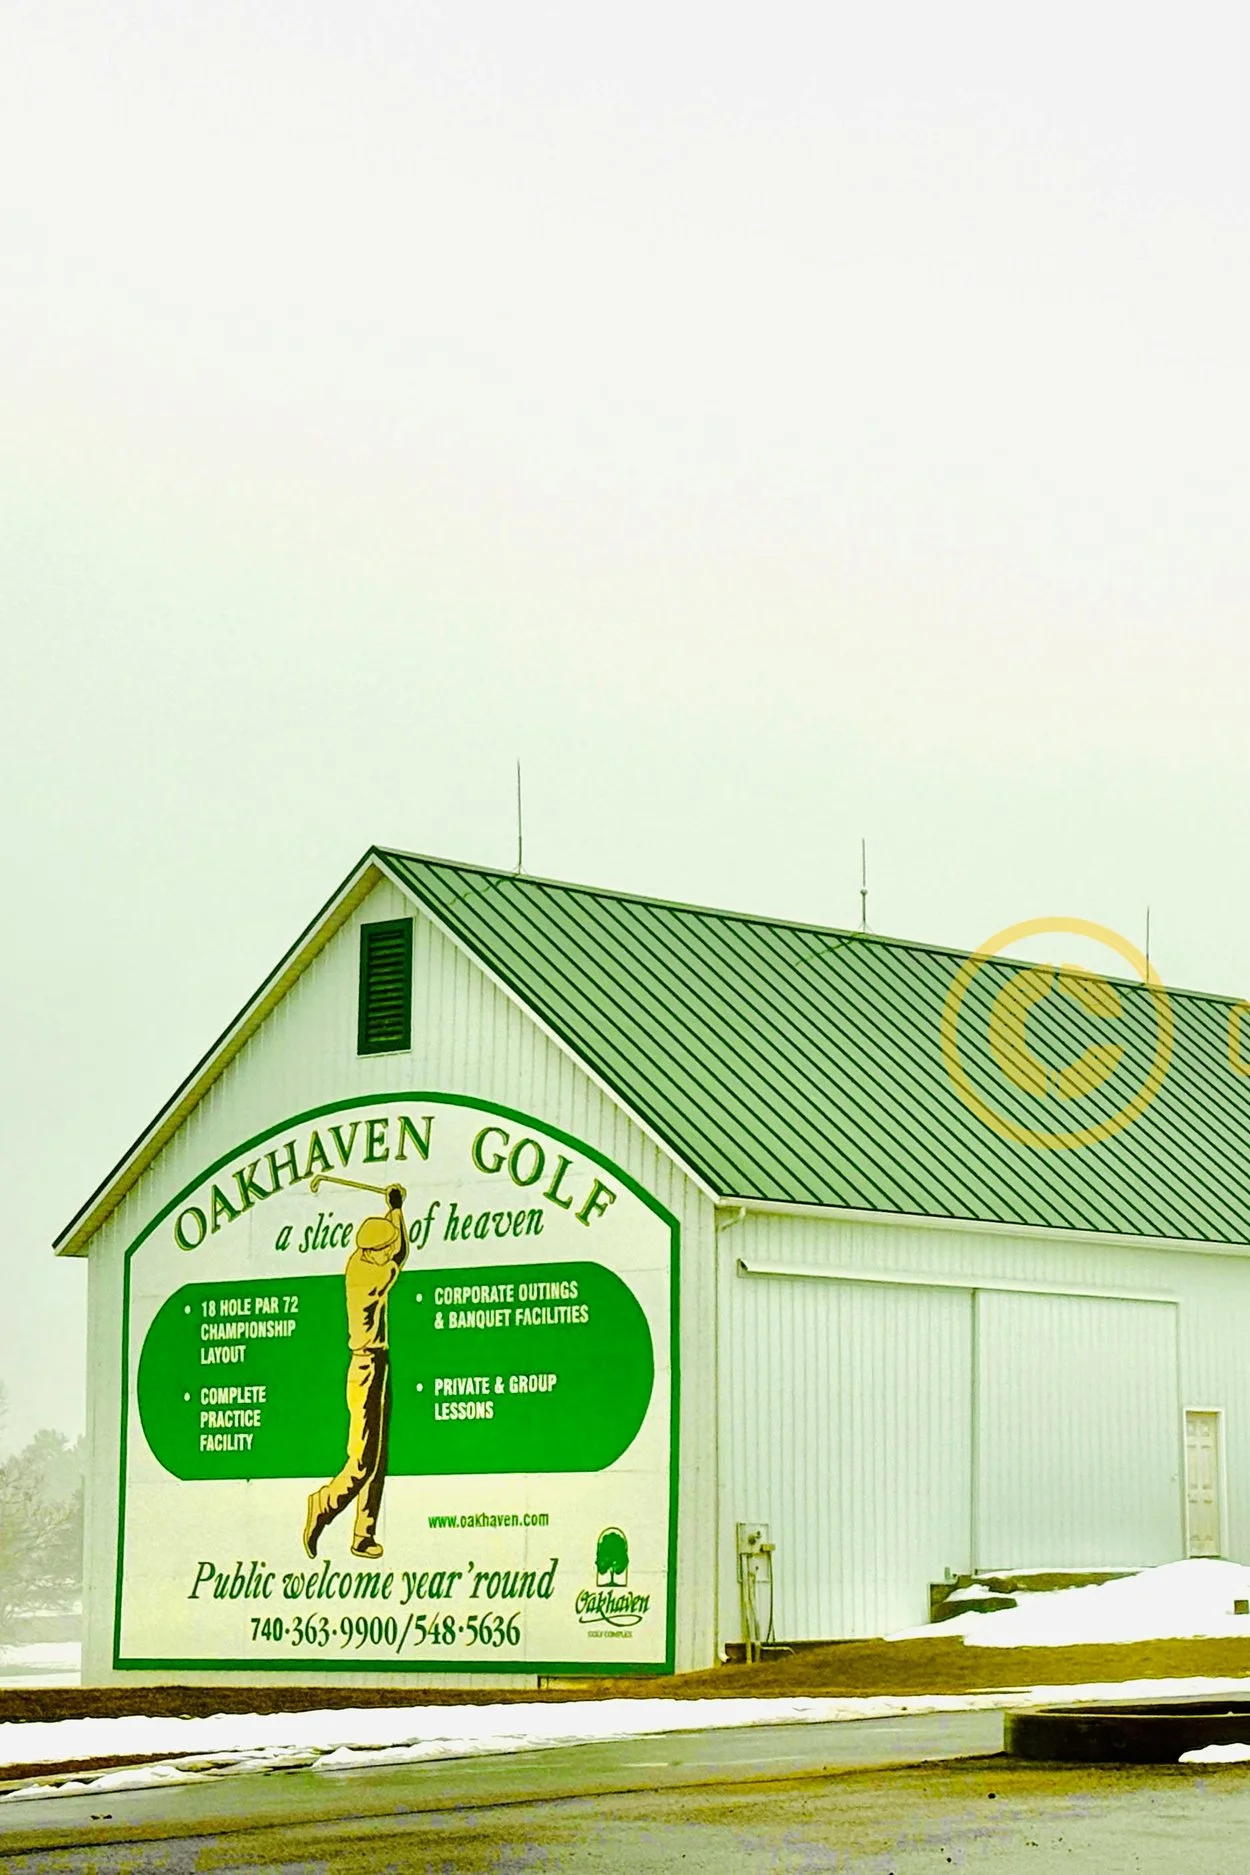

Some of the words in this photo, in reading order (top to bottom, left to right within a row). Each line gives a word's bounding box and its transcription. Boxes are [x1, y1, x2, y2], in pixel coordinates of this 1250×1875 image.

[173, 1115, 435, 1252] OAKHAVEN
[472, 1126, 617, 1228] GOLF
[275, 1225, 293, 1251] a
[298, 1211, 354, 1253] slice
[408, 1200, 440, 1250] of
[443, 1202, 545, 1241] heaven
[434, 1284, 514, 1305] CORPORATE
[518, 1281, 578, 1301] OUTINGS
[201, 1300, 216, 1317] 18
[220, 1298, 251, 1316] HOLE
[255, 1297, 279, 1314] PAR
[283, 1296, 299, 1313] 72
[434, 1311, 444, 1329] &
[448, 1308, 512, 1329] BANQUET
[515, 1304, 589, 1326] FACILITIES
[200, 1320, 296, 1341] CHAMPIONSHIP
[200, 1345, 246, 1365] LAYOUT
[200, 1386, 266, 1405] COMPLETE
[434, 1377, 490, 1396] PRIVATE
[494, 1376, 504, 1394] &
[509, 1374, 557, 1393] GROUP
[200, 1410, 261, 1428] PRACTICE
[434, 1401, 494, 1421] LESSONS
[200, 1433, 253, 1452] FACILITY
[428, 1512, 549, 1529] www.oakhaven.com
[188, 1561, 275, 1599] Public
[282, 1560, 394, 1600] welcome
[575, 1589, 651, 1627] Oakhaven
